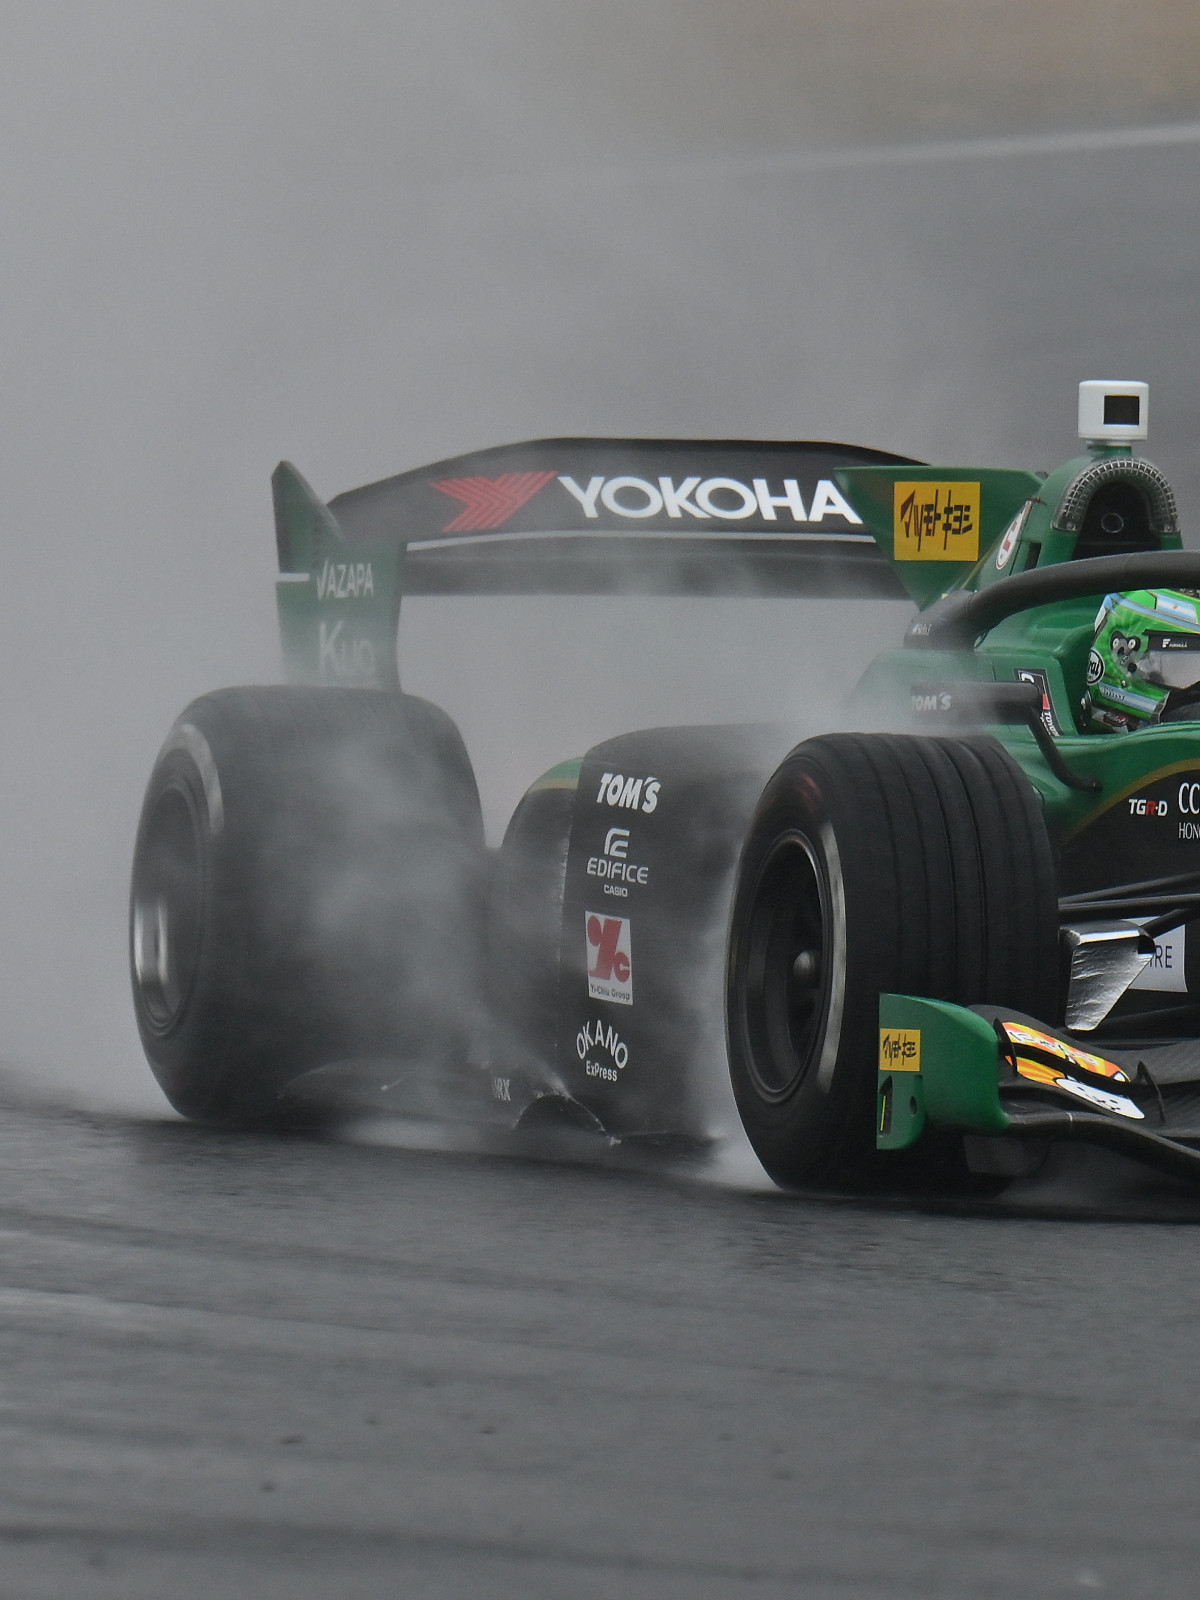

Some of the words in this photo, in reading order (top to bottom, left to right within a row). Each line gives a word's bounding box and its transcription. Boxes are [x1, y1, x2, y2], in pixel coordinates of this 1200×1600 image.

[596, 773, 661, 814] TOM'S
[586, 857, 649, 885] EDIFICE
[603, 884, 628, 898] CASIO
[577, 1019, 628, 1069] OKANO
